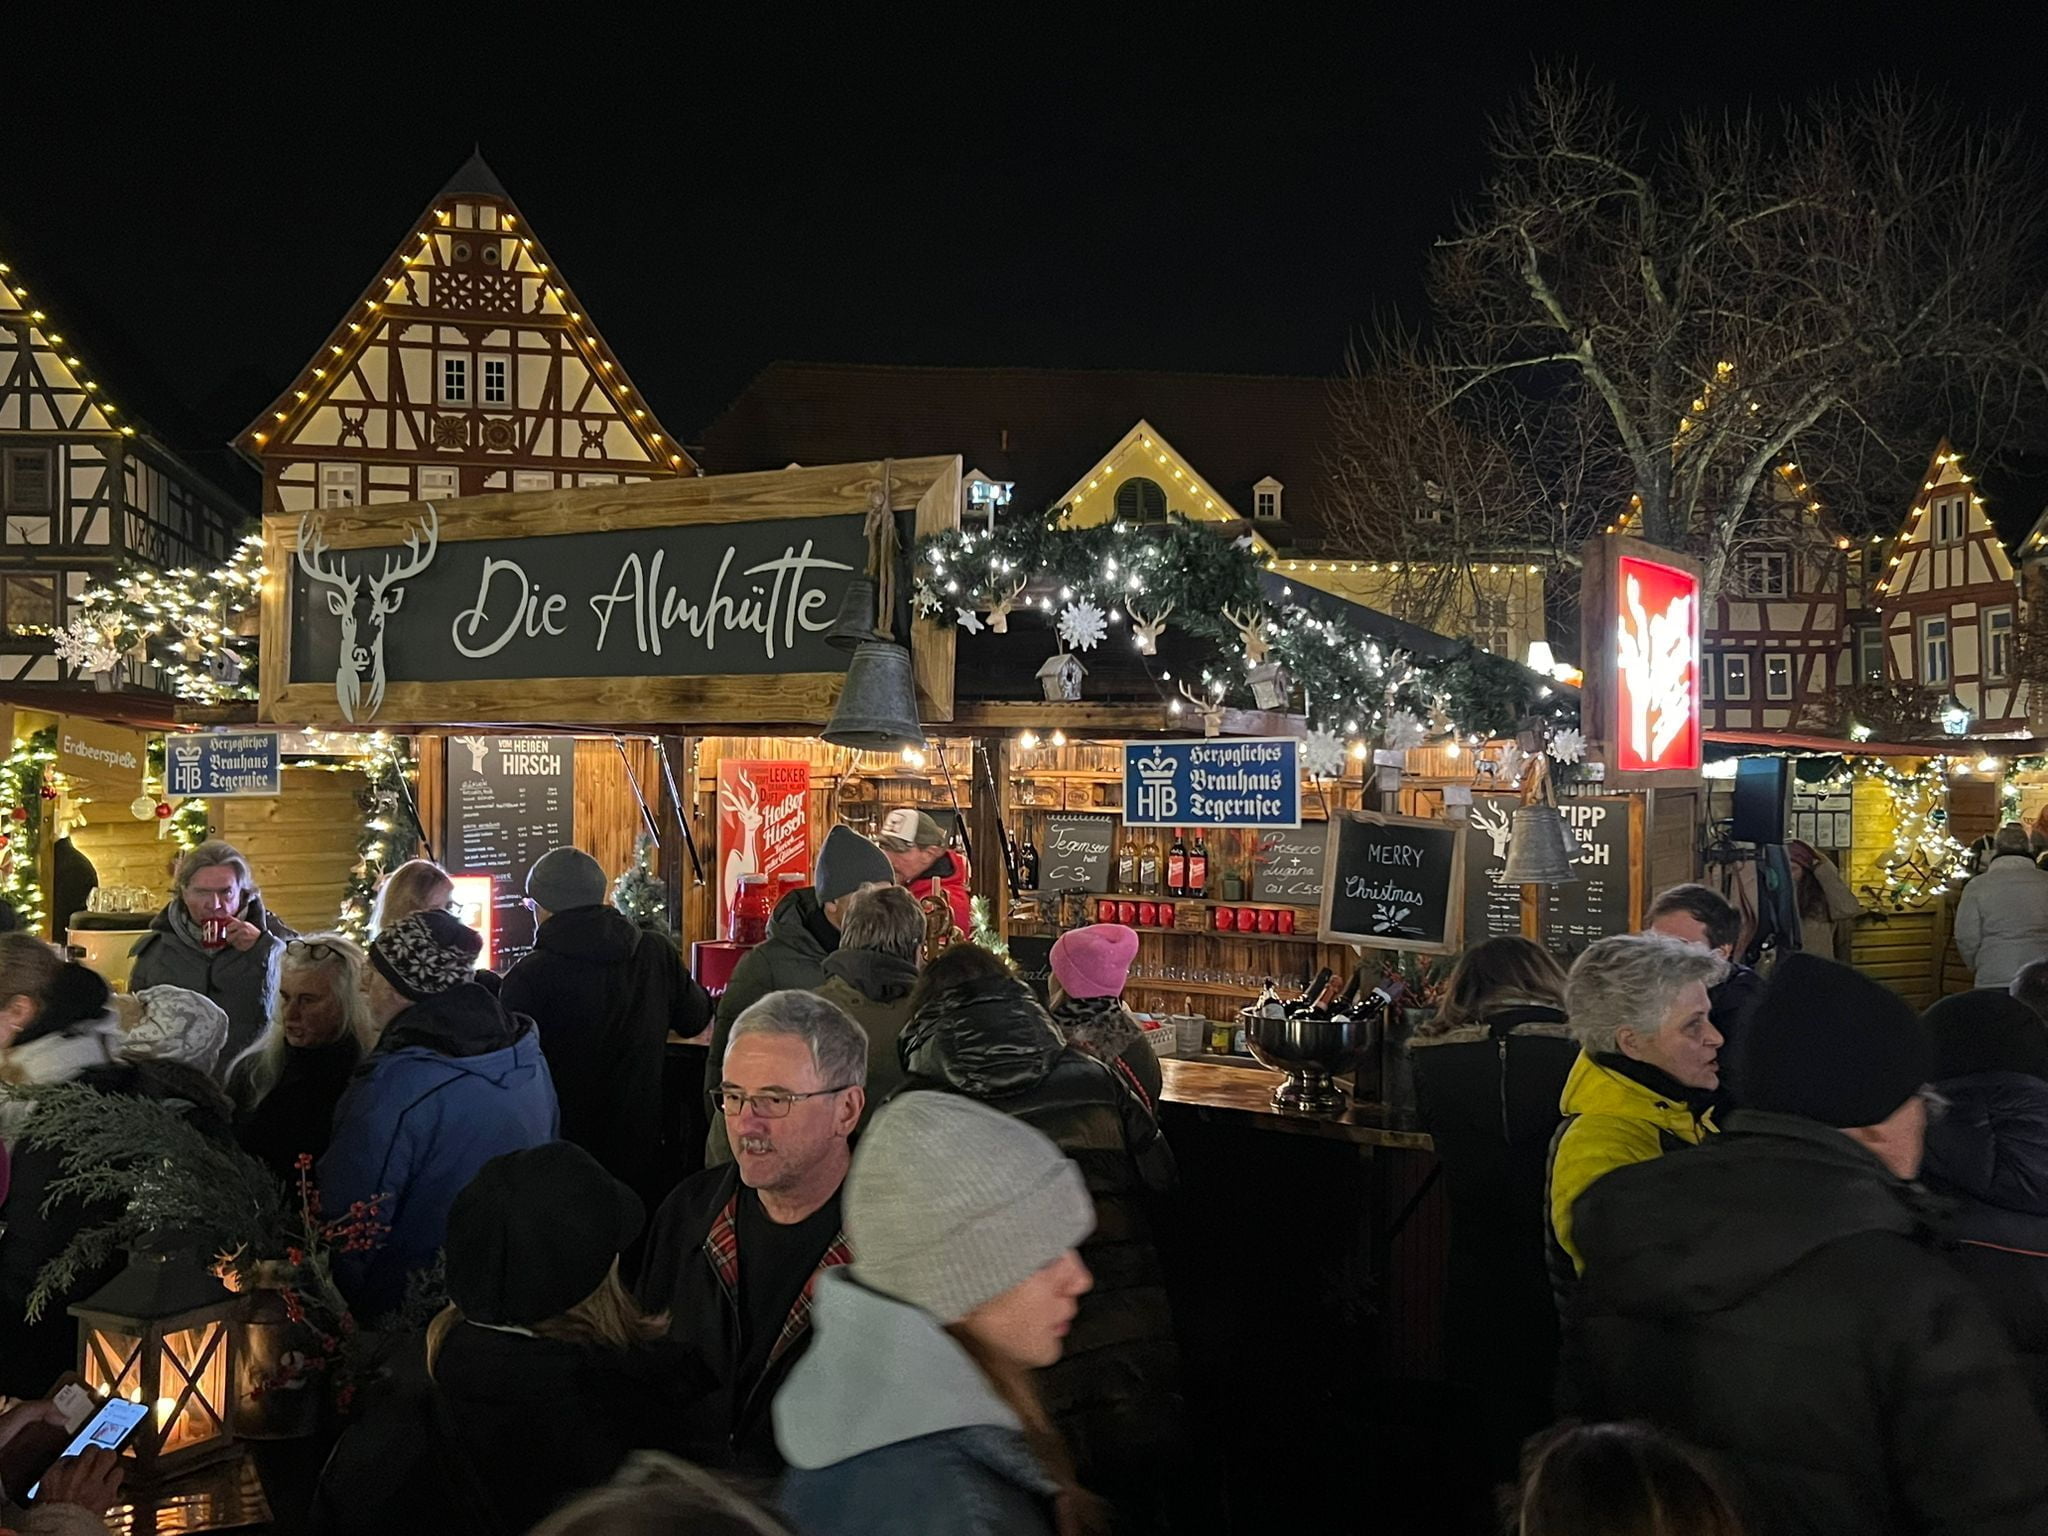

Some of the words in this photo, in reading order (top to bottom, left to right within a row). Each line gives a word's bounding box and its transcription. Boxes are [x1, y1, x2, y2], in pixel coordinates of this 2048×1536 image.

[452, 556, 568, 658] Die
[590, 539, 854, 659] Almhütte
[63, 735, 137, 769] Erdbeerspieße
[209, 753, 269, 772] Brauhaus
[503, 754, 561, 776] HIRSCH
[1189, 743, 1282, 767] Herzogliches
[769, 767, 805, 783] LECKER
[1189, 768, 1282, 797] Brauhaus
[762, 810, 806, 852] Hirsch
[1367, 843, 1424, 868] MERRY
[1345, 875, 1424, 906] Christmas
